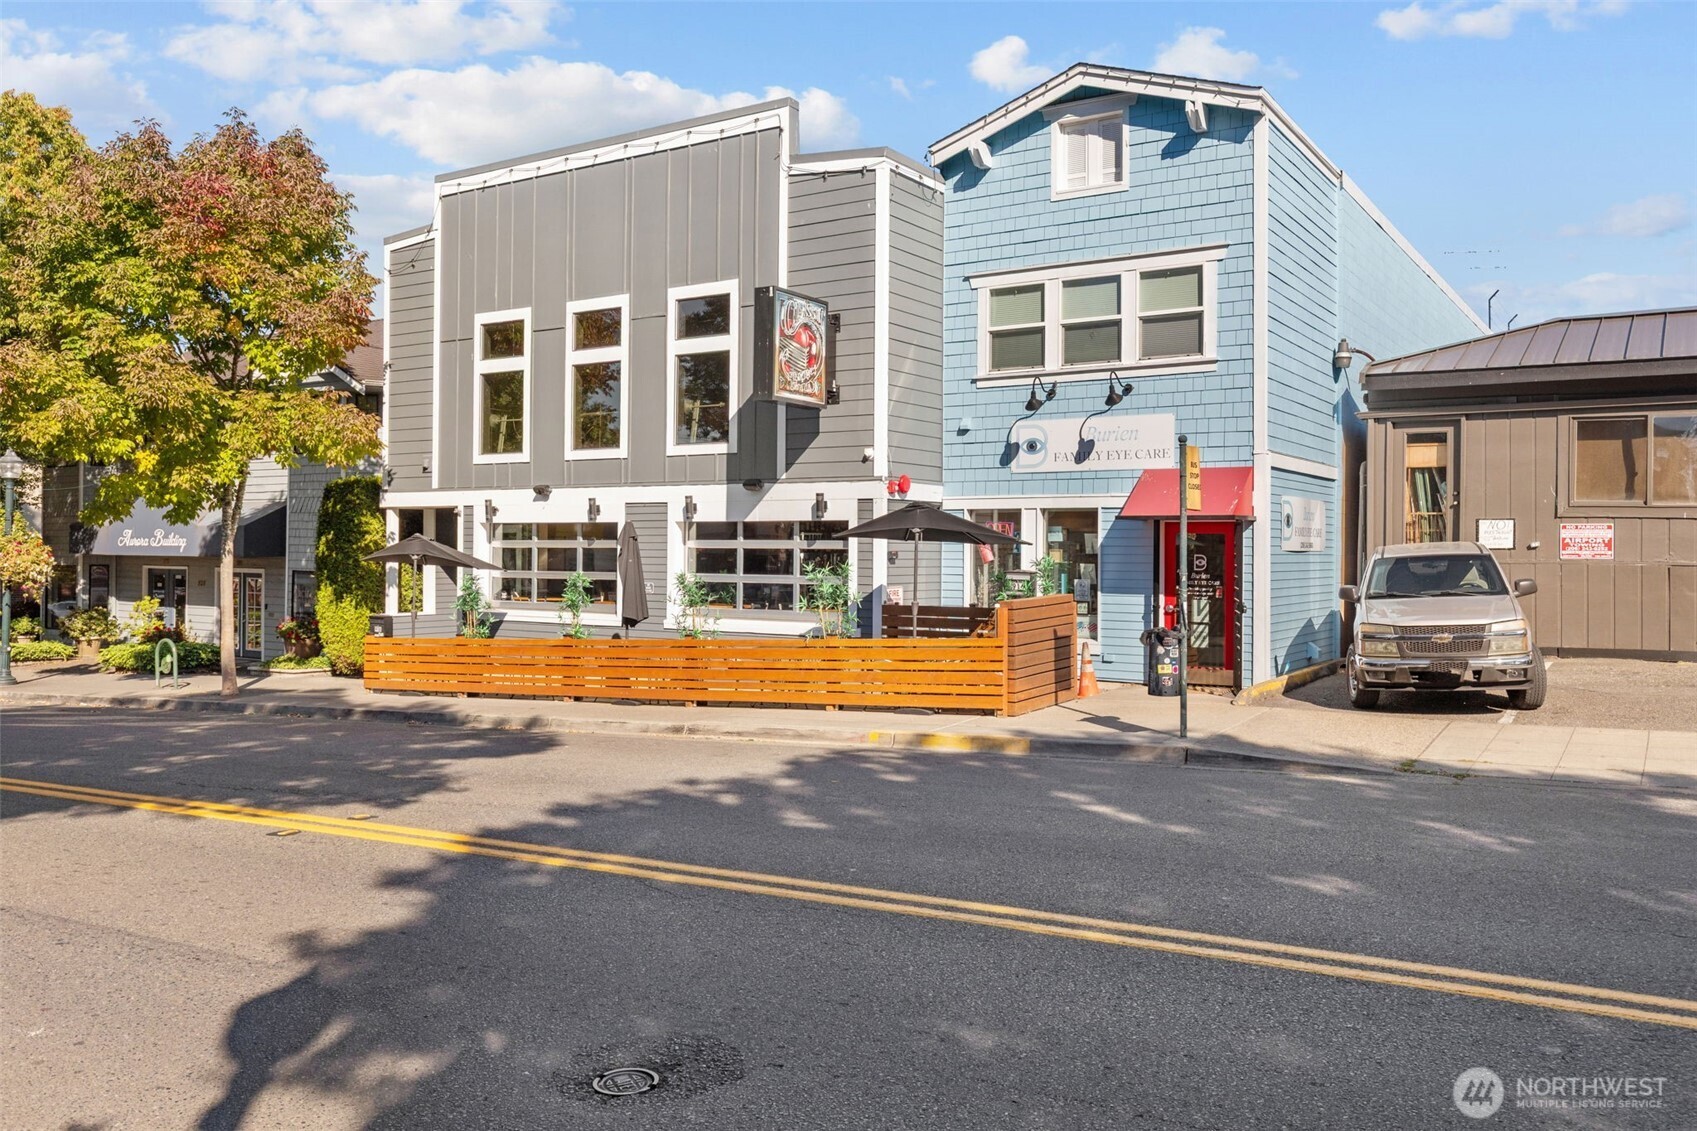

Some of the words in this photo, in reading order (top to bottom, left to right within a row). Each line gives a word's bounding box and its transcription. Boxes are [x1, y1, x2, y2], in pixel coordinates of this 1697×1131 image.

[1086, 426, 1139, 442] Burien
[1054, 450, 1103, 462] FAMILY
[1107, 449, 1132, 460] EYE
[1134, 448, 1171, 460] CARE
[117, 529, 149, 547] Aurora
[150, 528, 187, 553] Building
